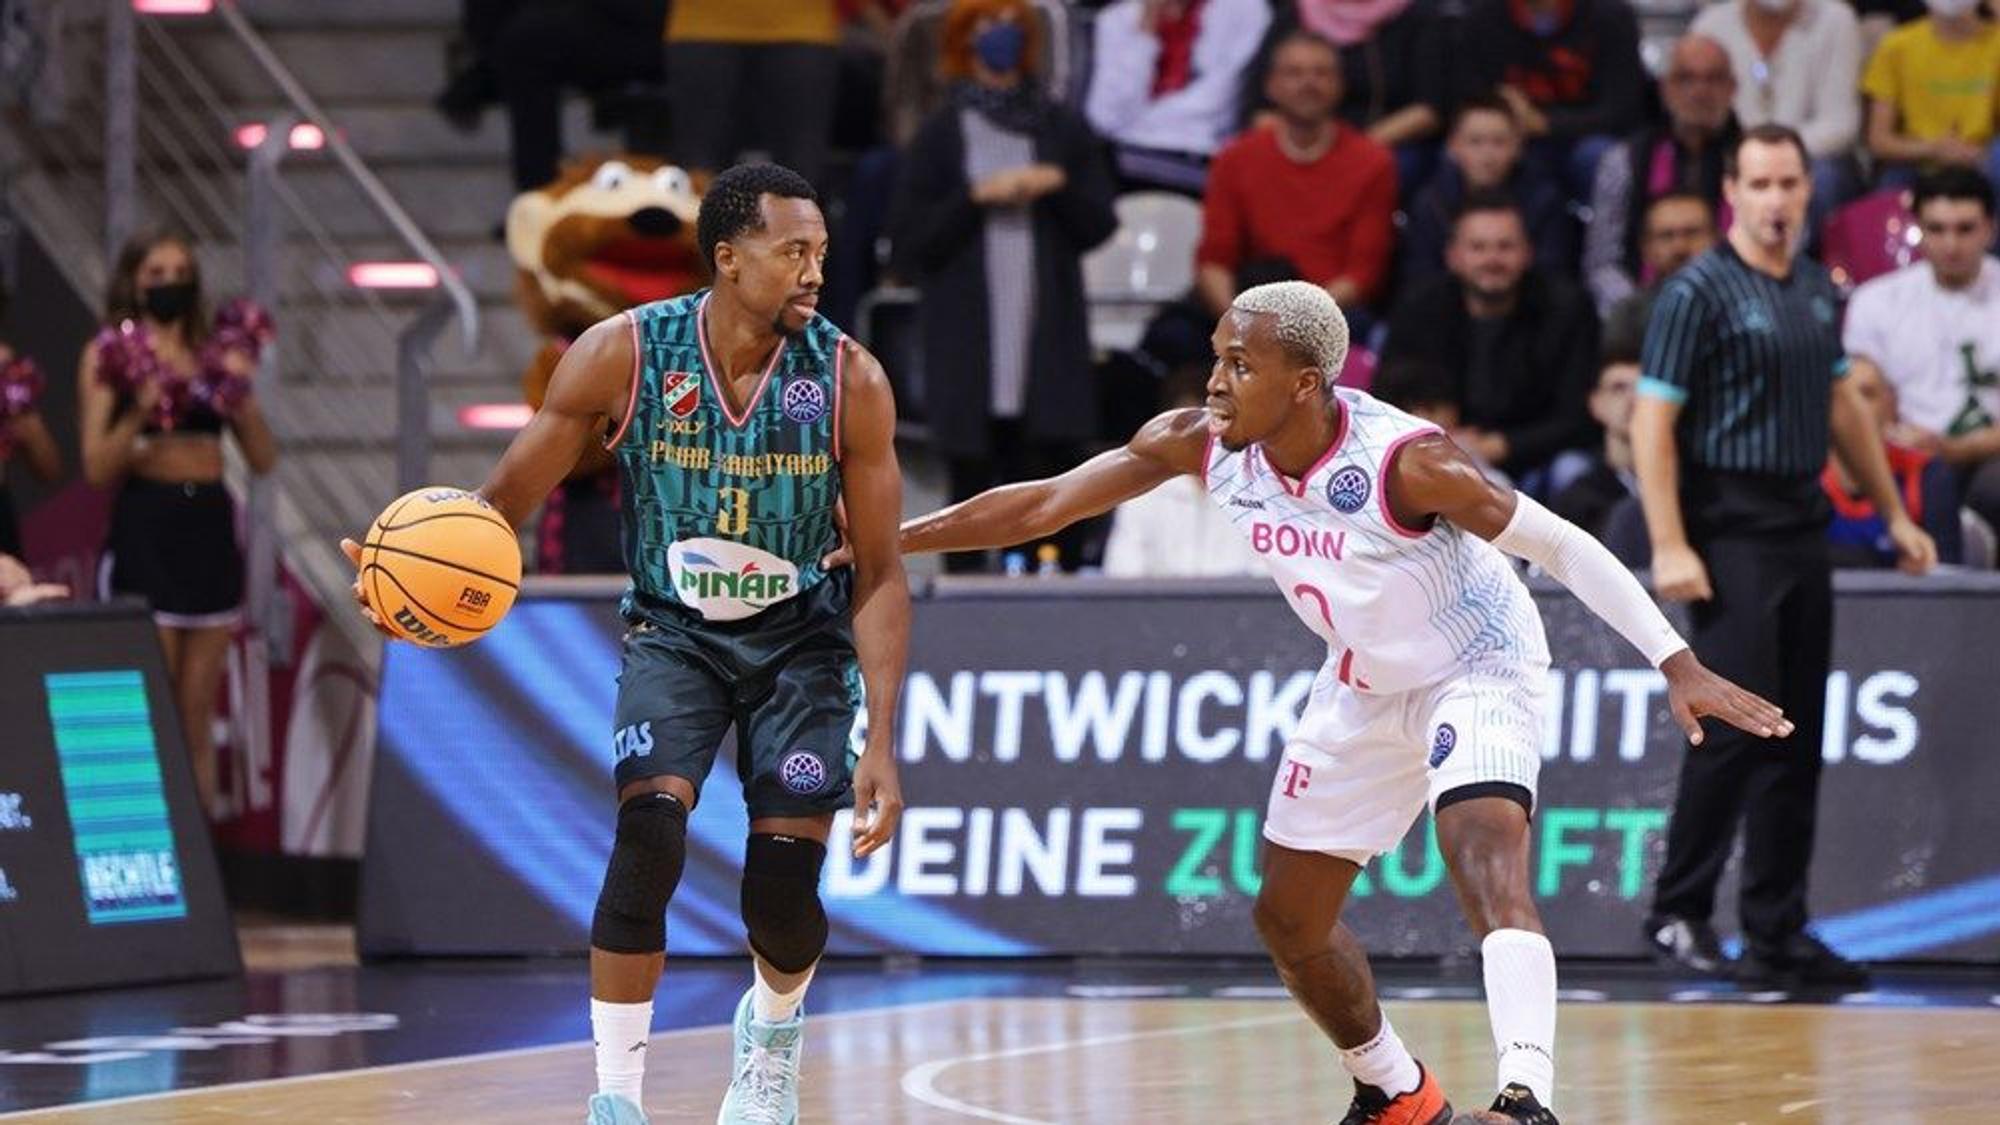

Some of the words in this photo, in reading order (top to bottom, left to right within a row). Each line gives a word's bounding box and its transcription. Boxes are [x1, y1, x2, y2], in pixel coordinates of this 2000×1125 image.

[716, 486, 751, 537] 3
[459, 587, 492, 608] FIBA
[903, 669, 1314, 763] NTWICK
[822, 806, 1142, 896] DEINE
